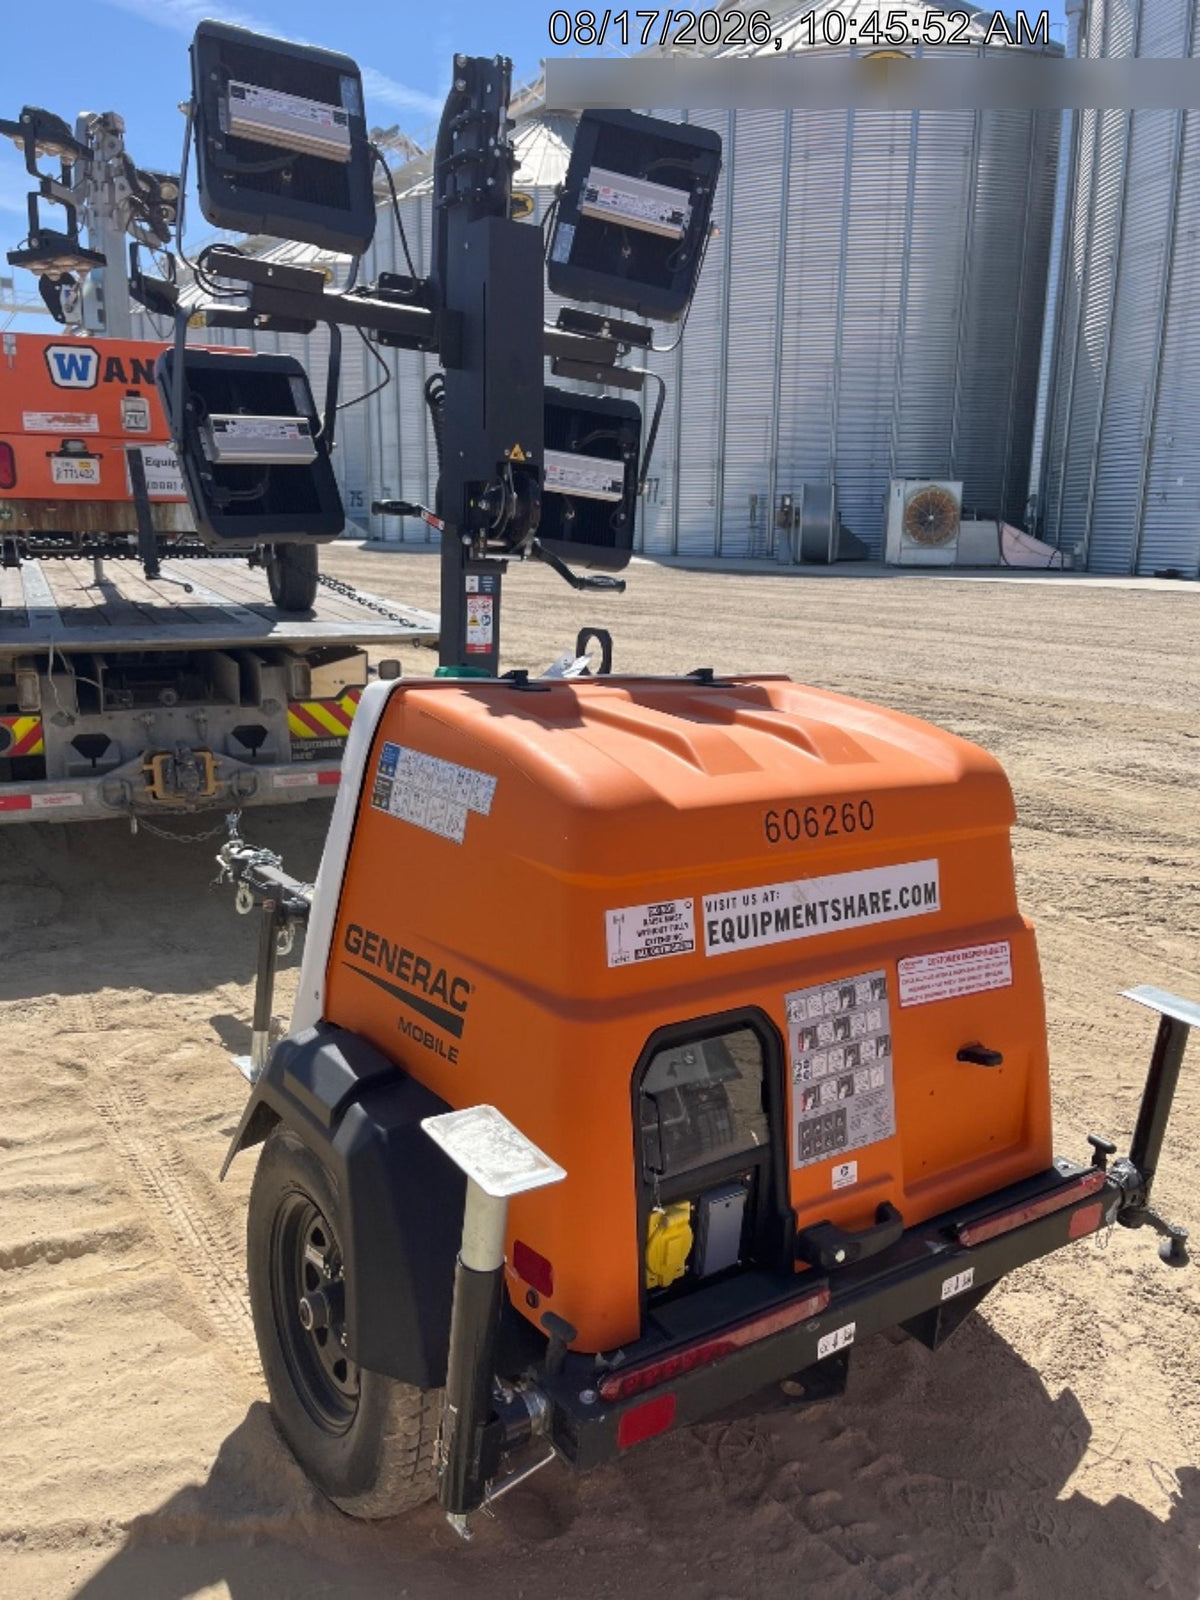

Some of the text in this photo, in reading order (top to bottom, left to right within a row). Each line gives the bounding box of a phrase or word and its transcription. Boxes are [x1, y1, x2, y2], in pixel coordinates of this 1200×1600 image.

[350, 490, 363, 507] 75
[765, 800, 874, 843] 606260
[705, 890, 780, 913] VISIT US AT:
[707, 881, 937, 946] EQUIPMENTSHARE.COM
[344, 923, 470, 1013] GENERAC
[398, 1016, 459, 1065] MOBILE
